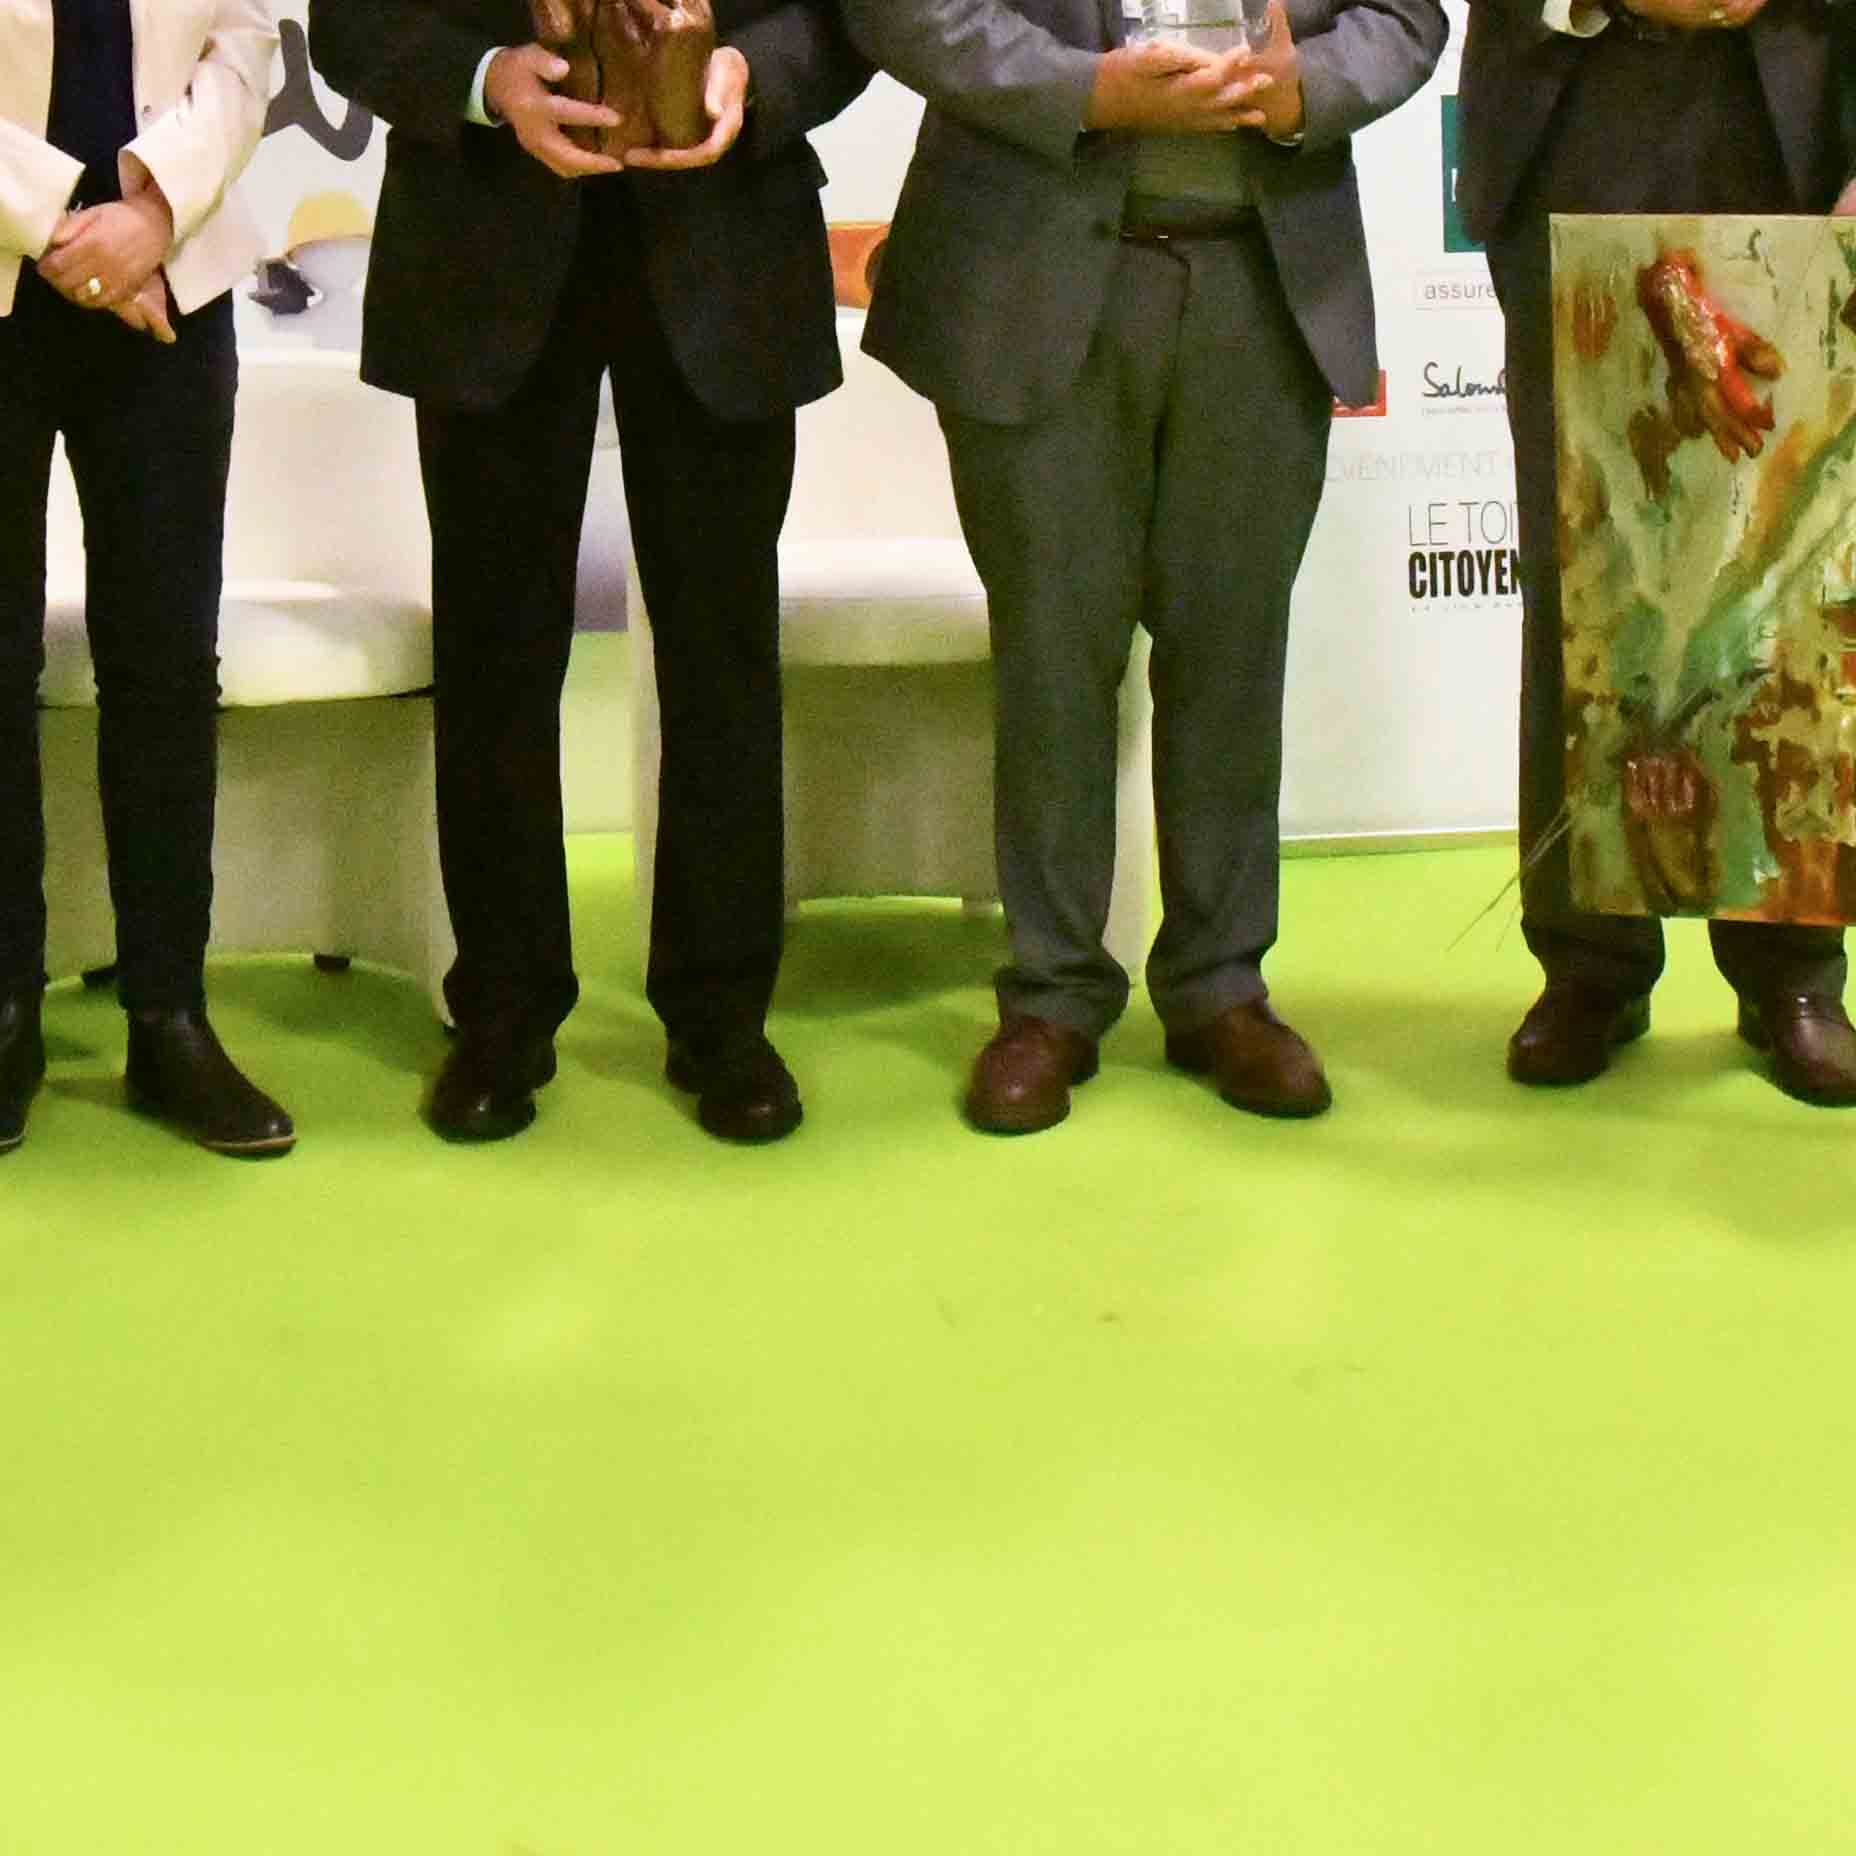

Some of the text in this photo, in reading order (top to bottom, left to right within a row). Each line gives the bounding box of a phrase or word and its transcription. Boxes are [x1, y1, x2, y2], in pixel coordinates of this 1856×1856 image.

[1424, 279, 1497, 301] assure
[1408, 499, 1519, 547] LE TOI
